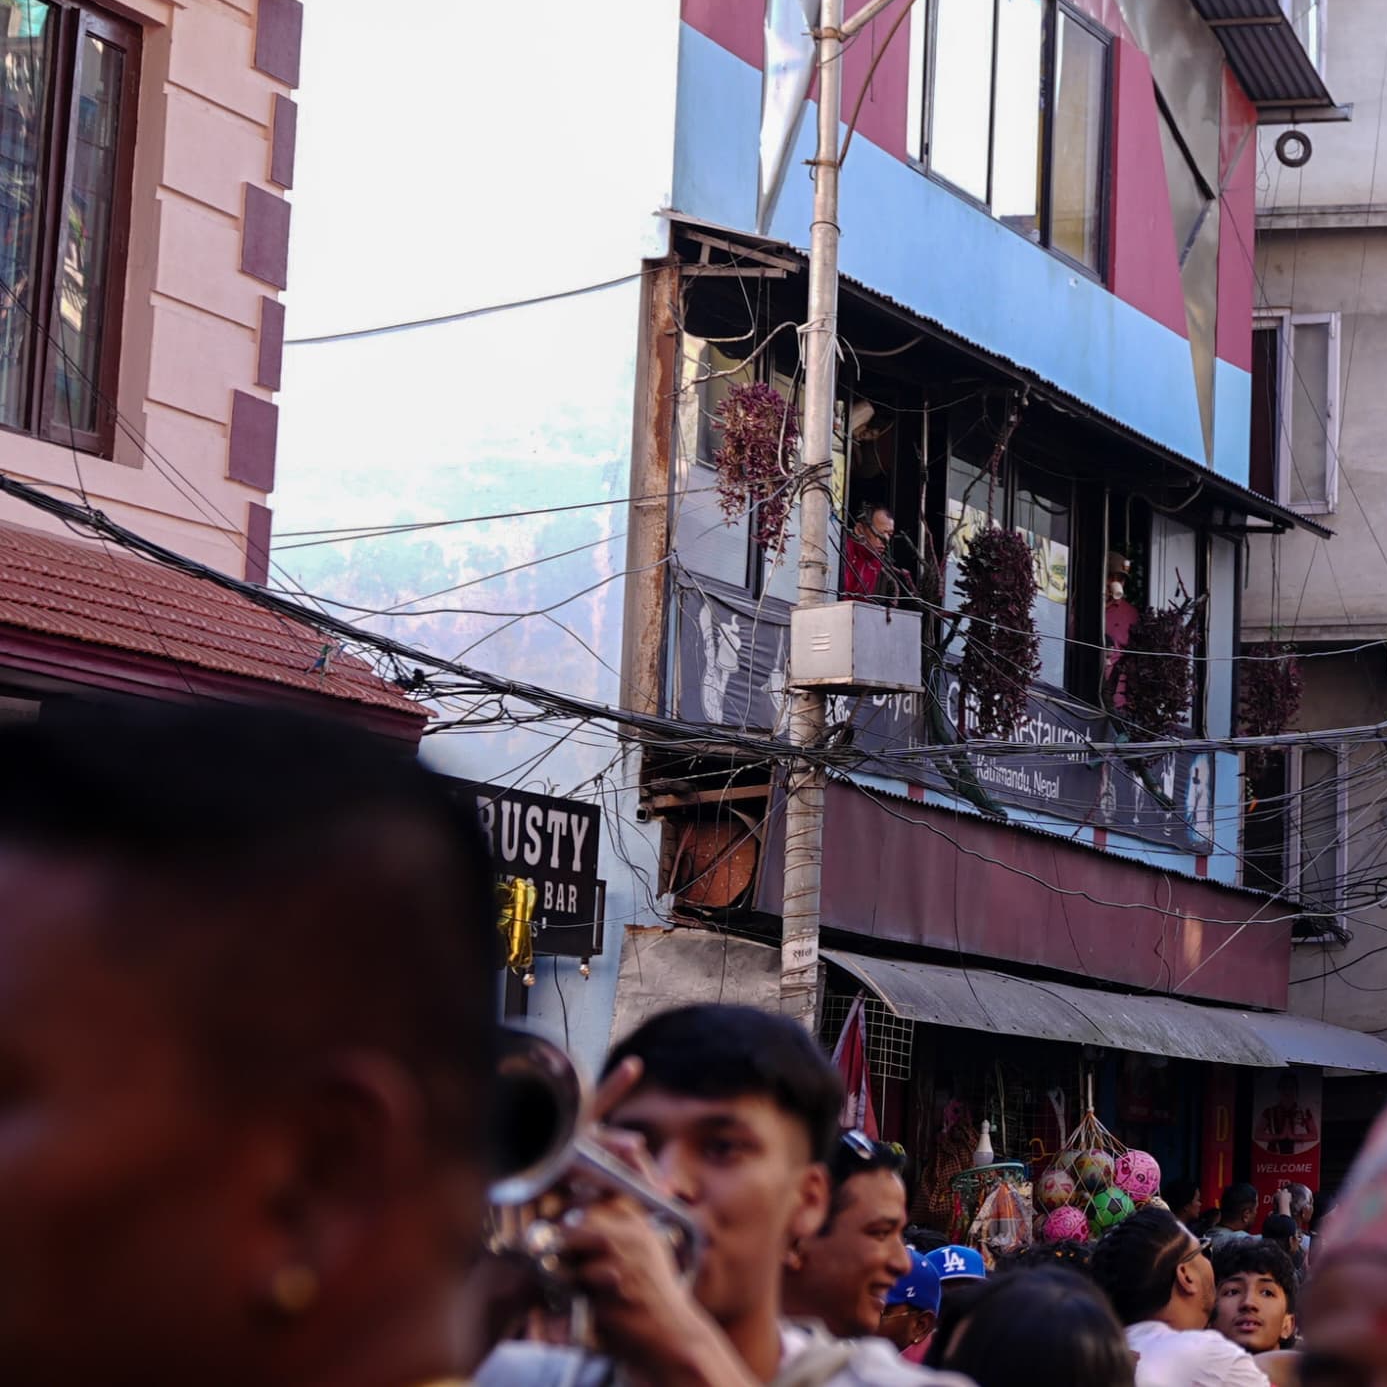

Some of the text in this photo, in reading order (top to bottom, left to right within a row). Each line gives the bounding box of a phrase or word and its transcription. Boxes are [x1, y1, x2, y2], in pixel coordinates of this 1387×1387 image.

[1008, 708, 1092, 764] estaurant
[1033, 770, 1060, 803] Nepal
[477, 796, 590, 872] RUSTY
[544, 880, 578, 914] BAR
[1256, 1163, 1313, 1174] WELCOME
[942, 1247, 966, 1272] LA
